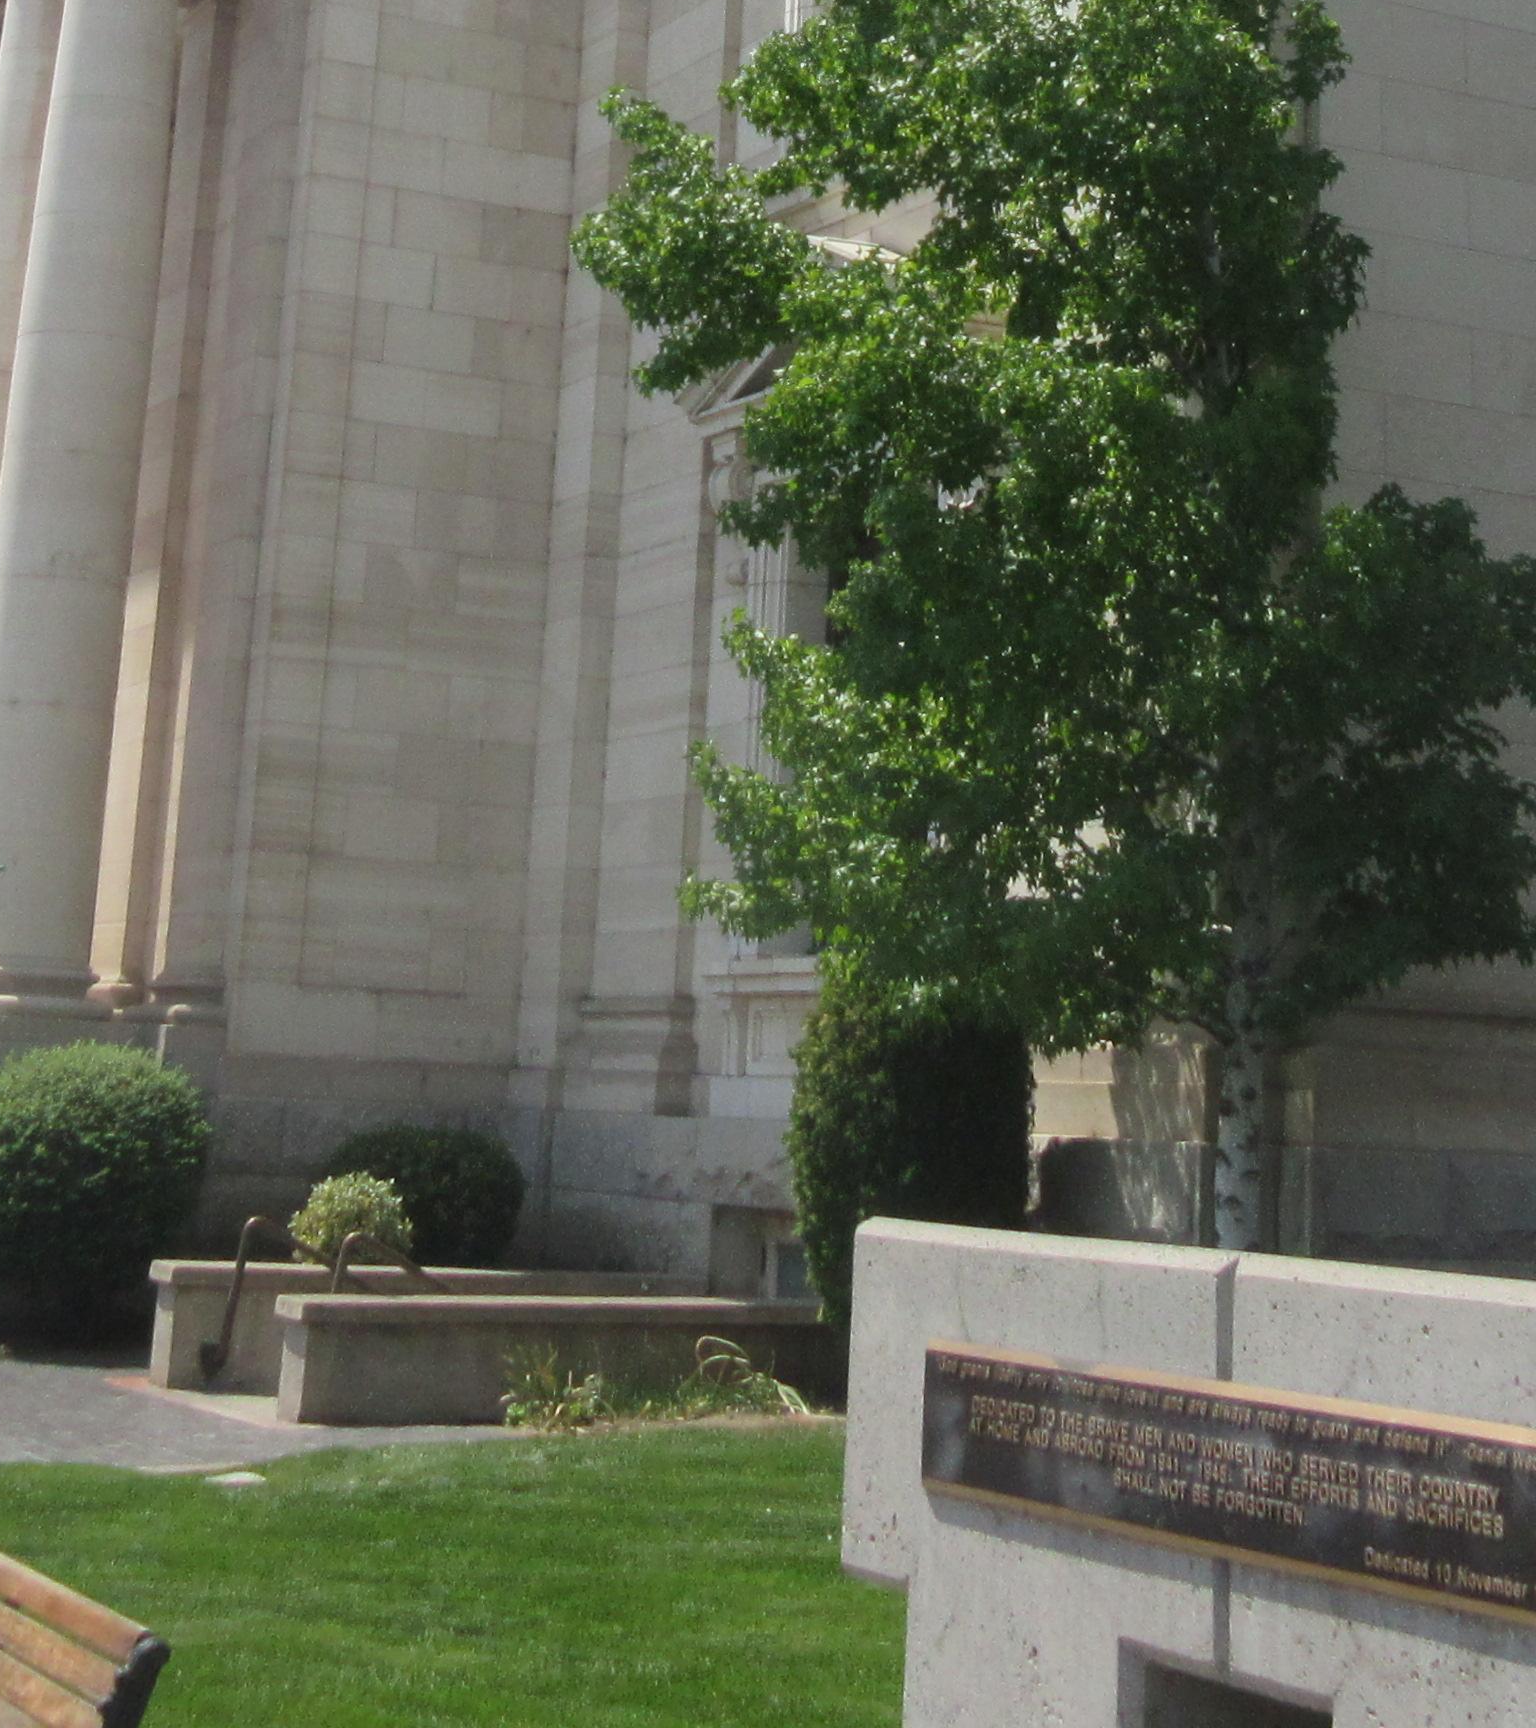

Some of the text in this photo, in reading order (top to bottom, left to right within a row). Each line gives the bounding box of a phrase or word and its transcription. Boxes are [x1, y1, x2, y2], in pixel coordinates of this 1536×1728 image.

[968, 1415, 981, 1434] AT
[987, 1419, 1019, 1442] HOME
[1024, 1425, 1048, 1448] AND
[1054, 1431, 1104, 1459] ABROAD
[1109, 1441, 1145, 1467] FROM
[1242, 1467, 1284, 1495] THEIR
[1290, 1477, 1358, 1510] EFFORTS
[1366, 1491, 1397, 1517] AND
[1405, 1498, 1503, 1535] SACRIFICES
[971, 1394, 1500, 1512] DEDICATED TO THE BRAVE MEN AND WOMEN WHO SERVED THEIR COUNTRY
[1112, 1471, 1154, 1494] SHALL
[1160, 1479, 1186, 1501] NOT
[1192, 1486, 1212, 1507] BE
[1364, 1545, 1431, 1580] Dedicated
[1433, 1564, 1452, 1586] 10
[1454, 1567, 1528, 1602] November
